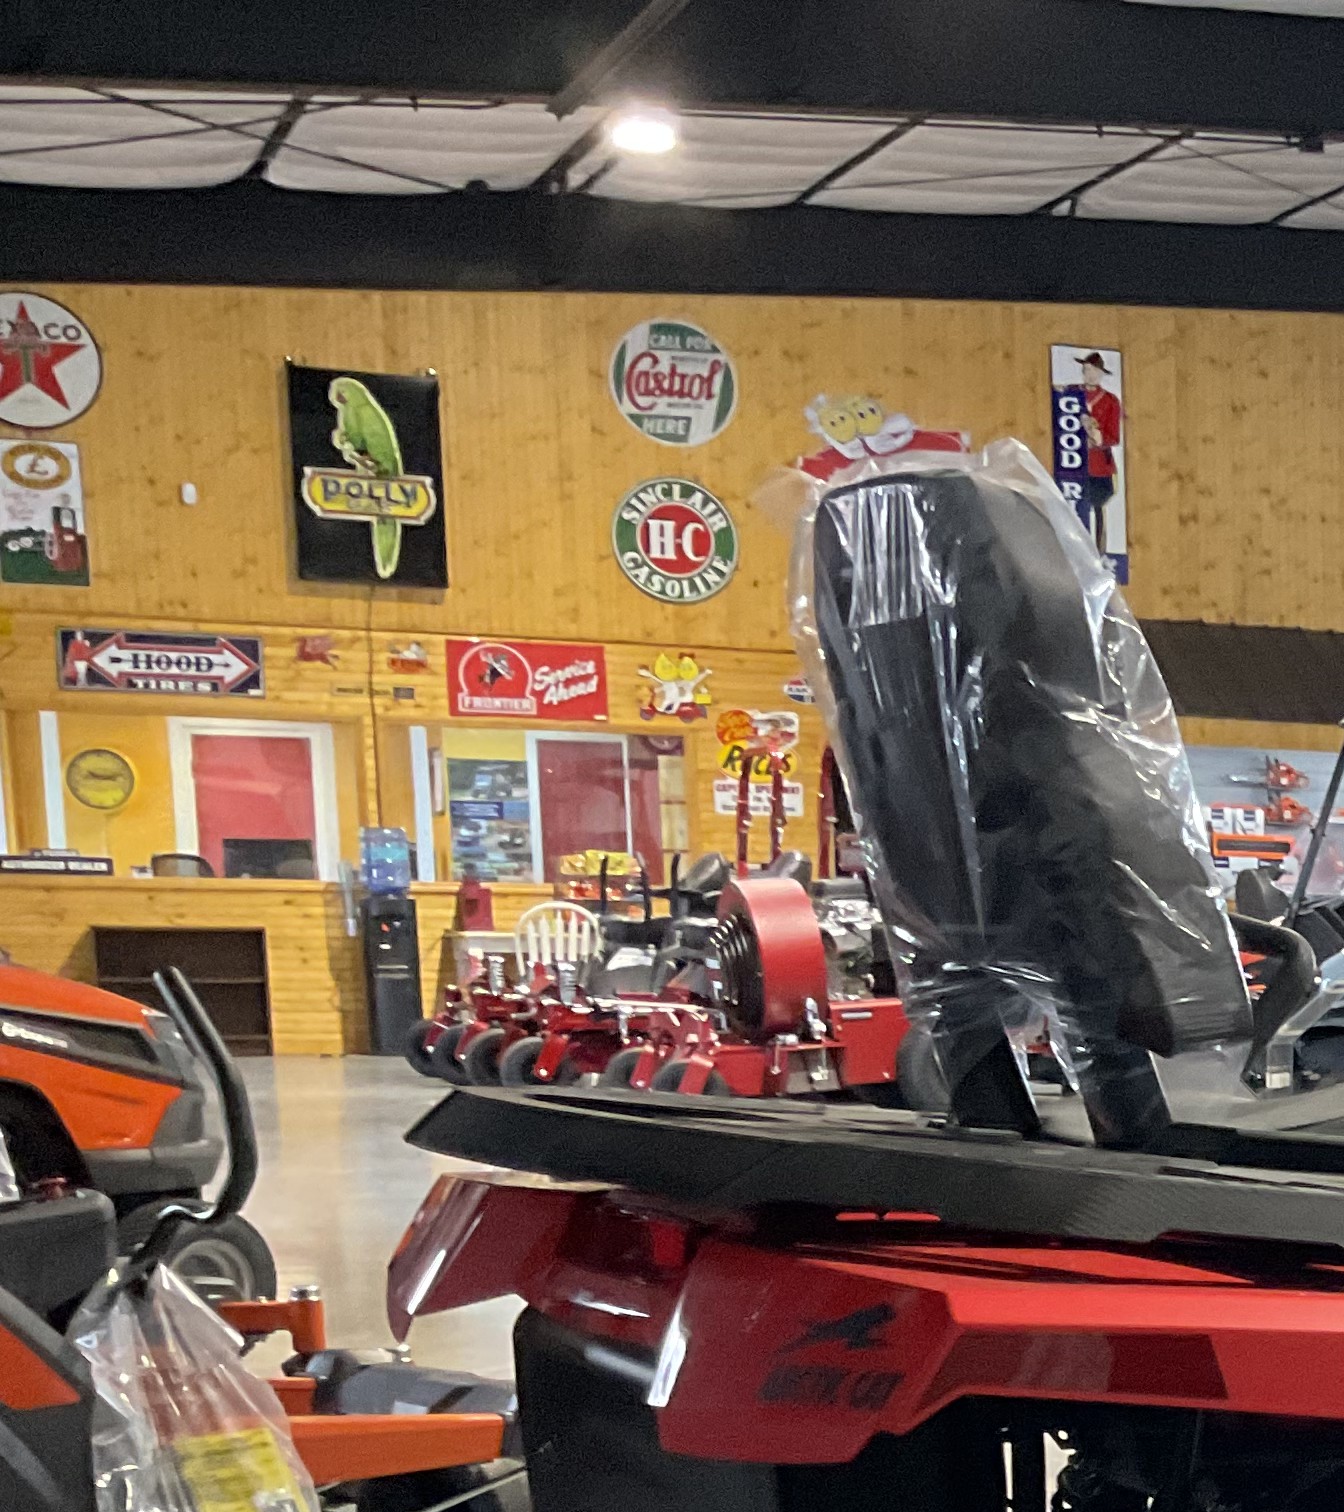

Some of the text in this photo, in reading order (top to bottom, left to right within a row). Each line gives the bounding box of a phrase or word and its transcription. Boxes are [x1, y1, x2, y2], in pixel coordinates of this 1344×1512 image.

[625, 351, 725, 411] Castrol
[641, 419, 688, 435] HERE
[1058, 396, 1083, 470] GOOD
[321, 478, 418, 508] POLLY
[621, 483, 727, 533] SINCLAIR
[623, 551, 732, 598] GASOLINE
[130, 653, 213, 673] HOOD
[533, 660, 596, 690] Service
[134, 678, 212, 692] TIRES
[543, 675, 599, 705] Ahead
